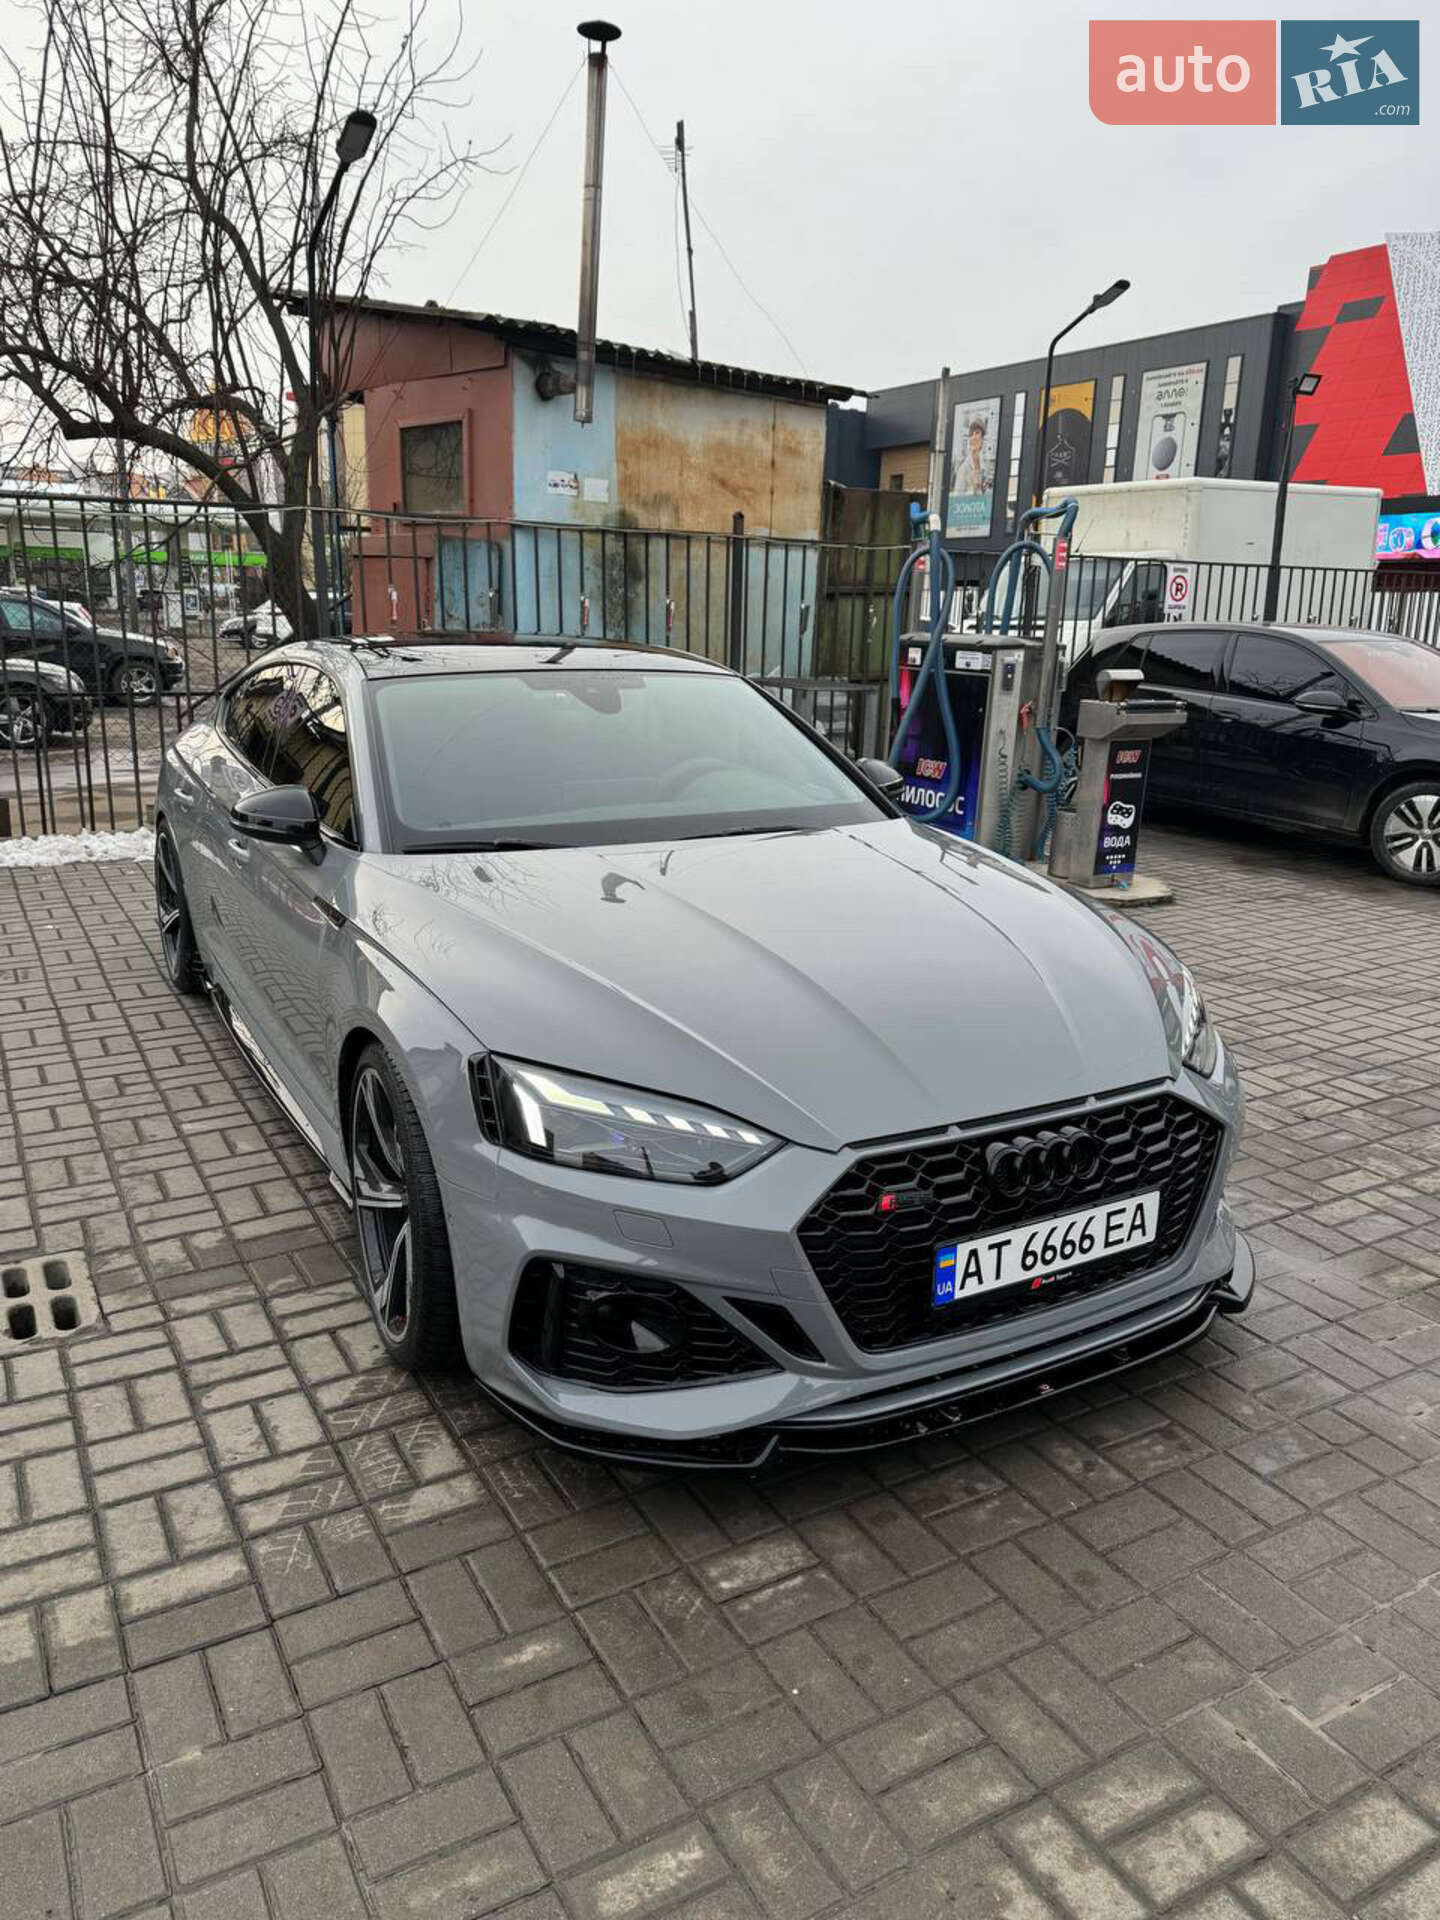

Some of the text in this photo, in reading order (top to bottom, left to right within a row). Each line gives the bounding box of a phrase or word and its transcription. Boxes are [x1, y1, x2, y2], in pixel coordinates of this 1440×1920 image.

[1104, 835, 1132, 849] ВОДА
[959, 1202, 1147, 1290] AT 6666 EA
[937, 1281, 953, 1296] UA
